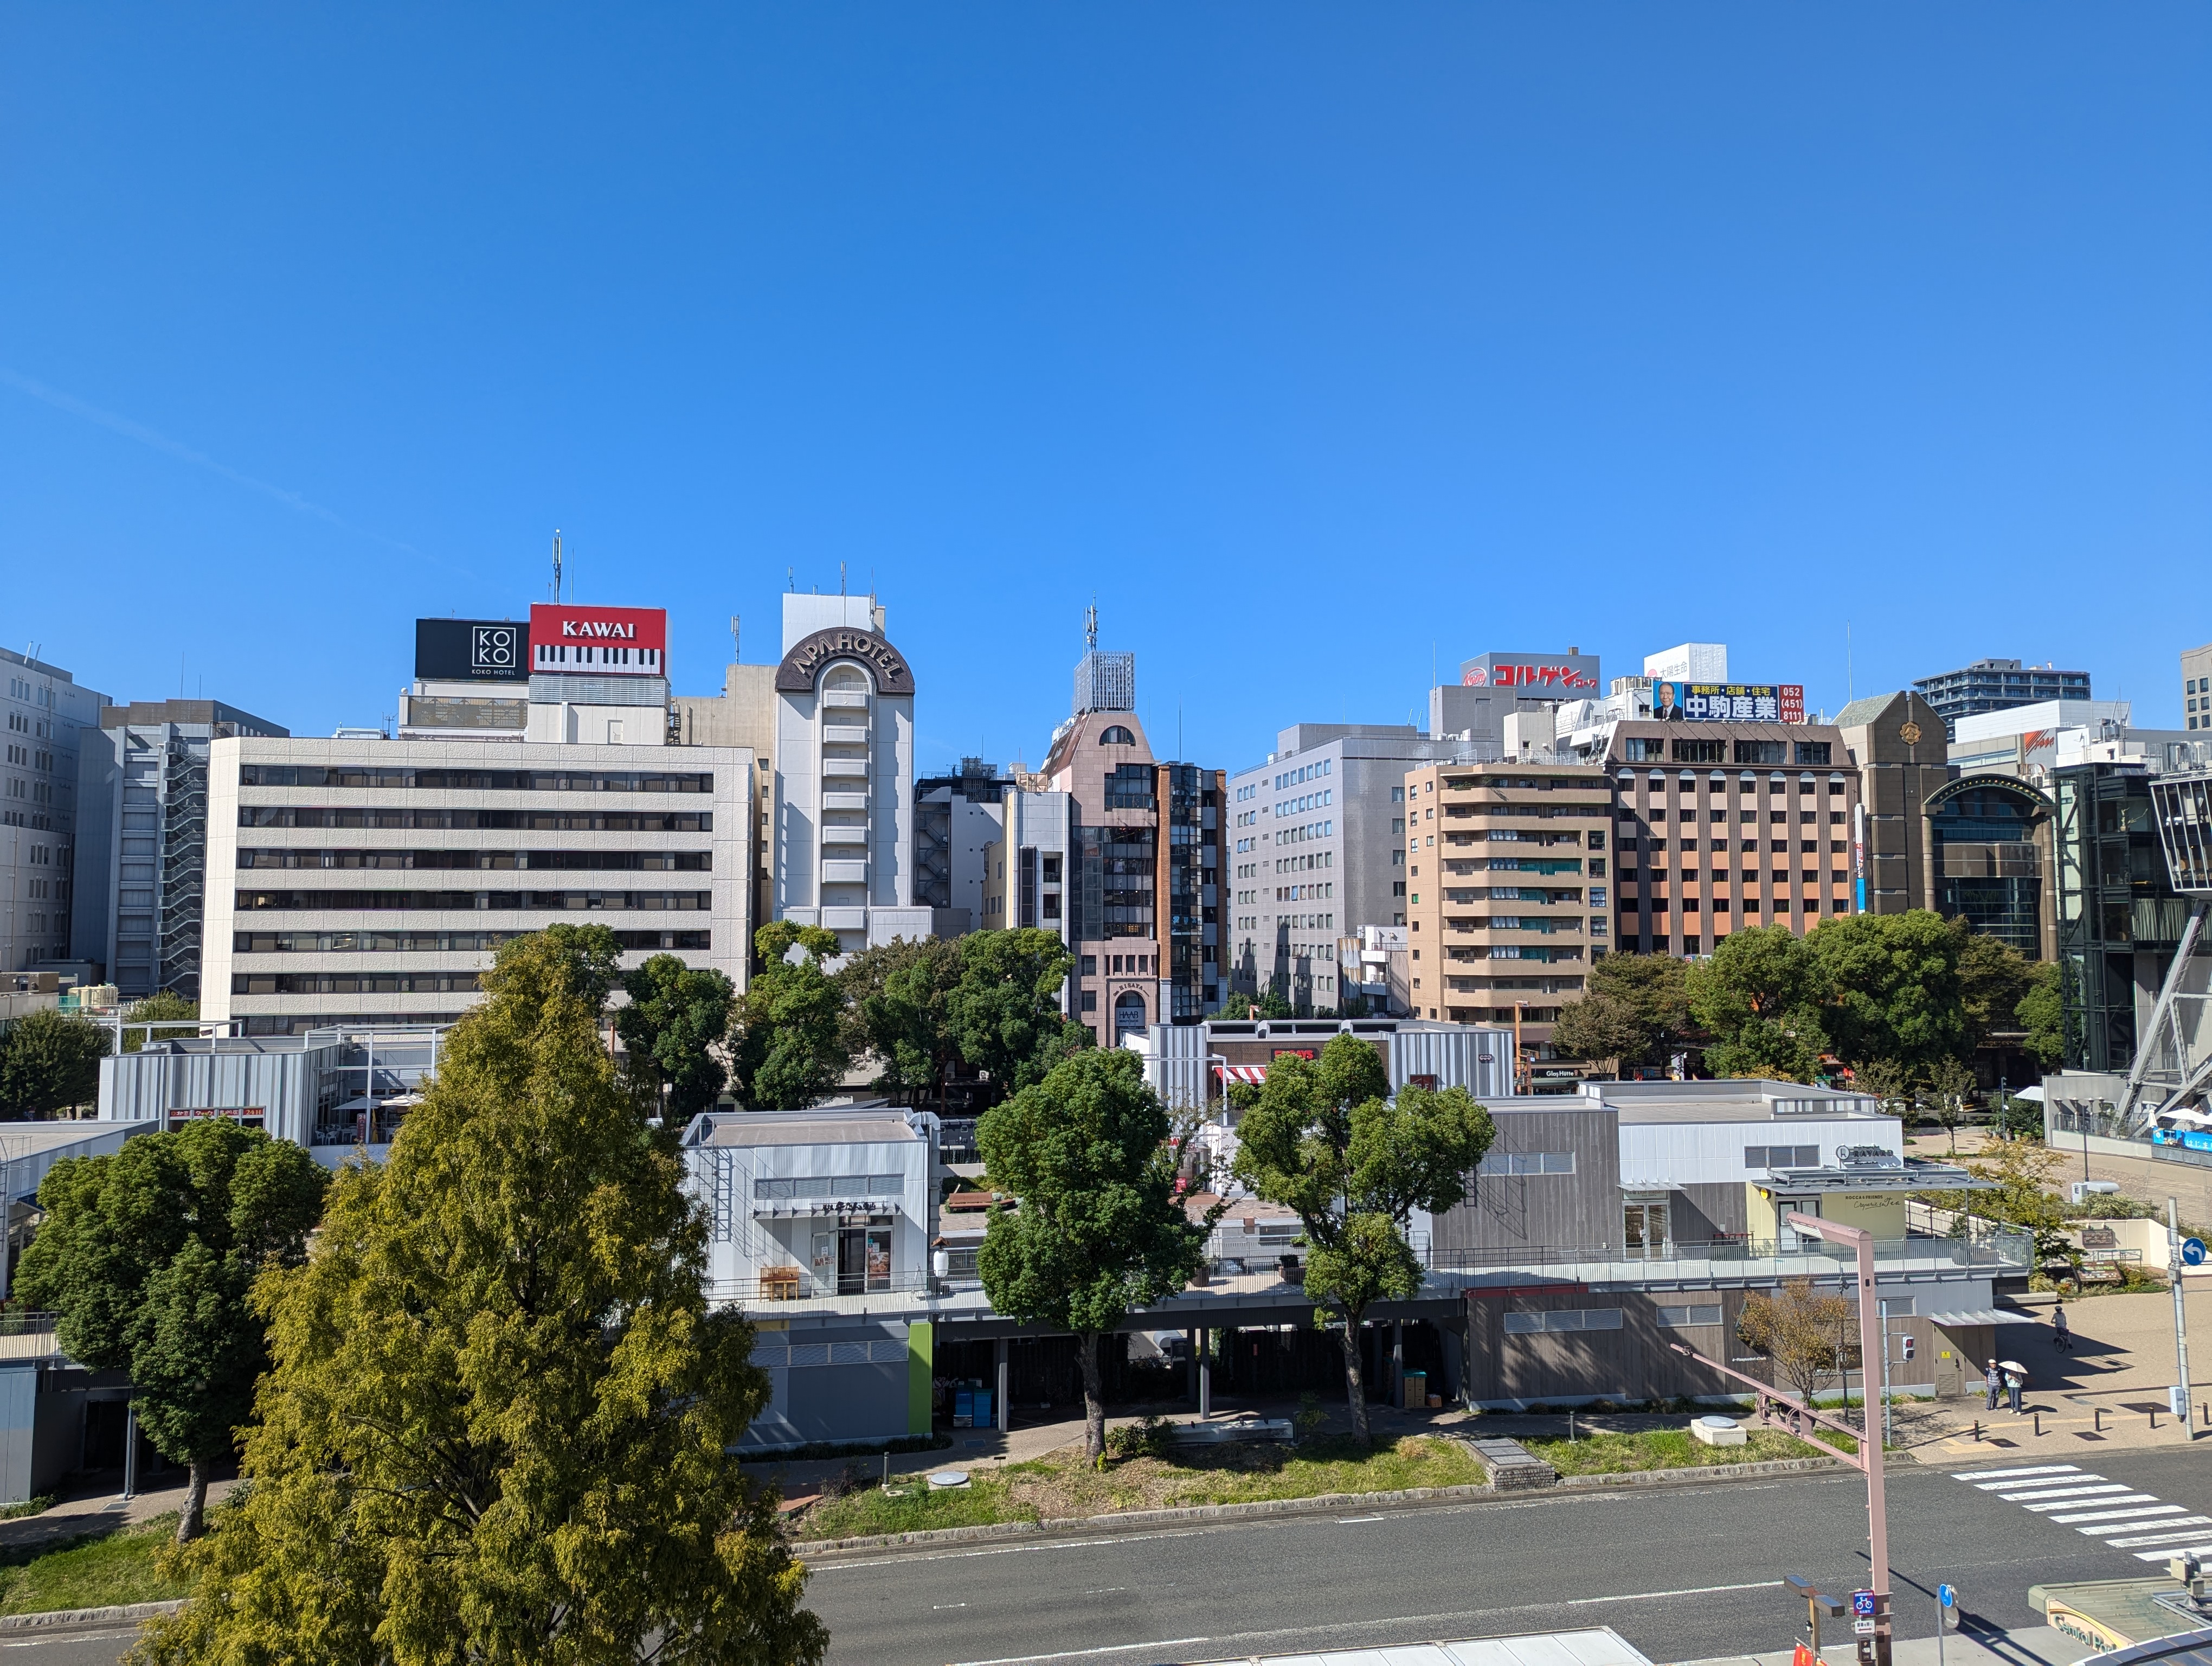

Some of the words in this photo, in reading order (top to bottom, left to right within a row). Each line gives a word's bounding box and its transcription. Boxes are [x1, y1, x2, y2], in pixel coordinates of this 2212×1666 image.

[563, 621, 634, 638] KAWAI
[480, 631, 510, 646] KO
[479, 648, 510, 663] KO
[793, 637, 835, 674] APA
[838, 633, 901, 678] HOTEL
[1660, 661, 1687, 679] 太陽生命
[1783, 688, 1800, 696] 052
[1686, 695, 1776, 719] 中駒産業
[1781, 699, 1803, 709] (451)
[1783, 711, 1802, 721] 8111
[1118, 983, 1143, 991] HISAYA
[2054, 1614, 2093, 1646] Central
